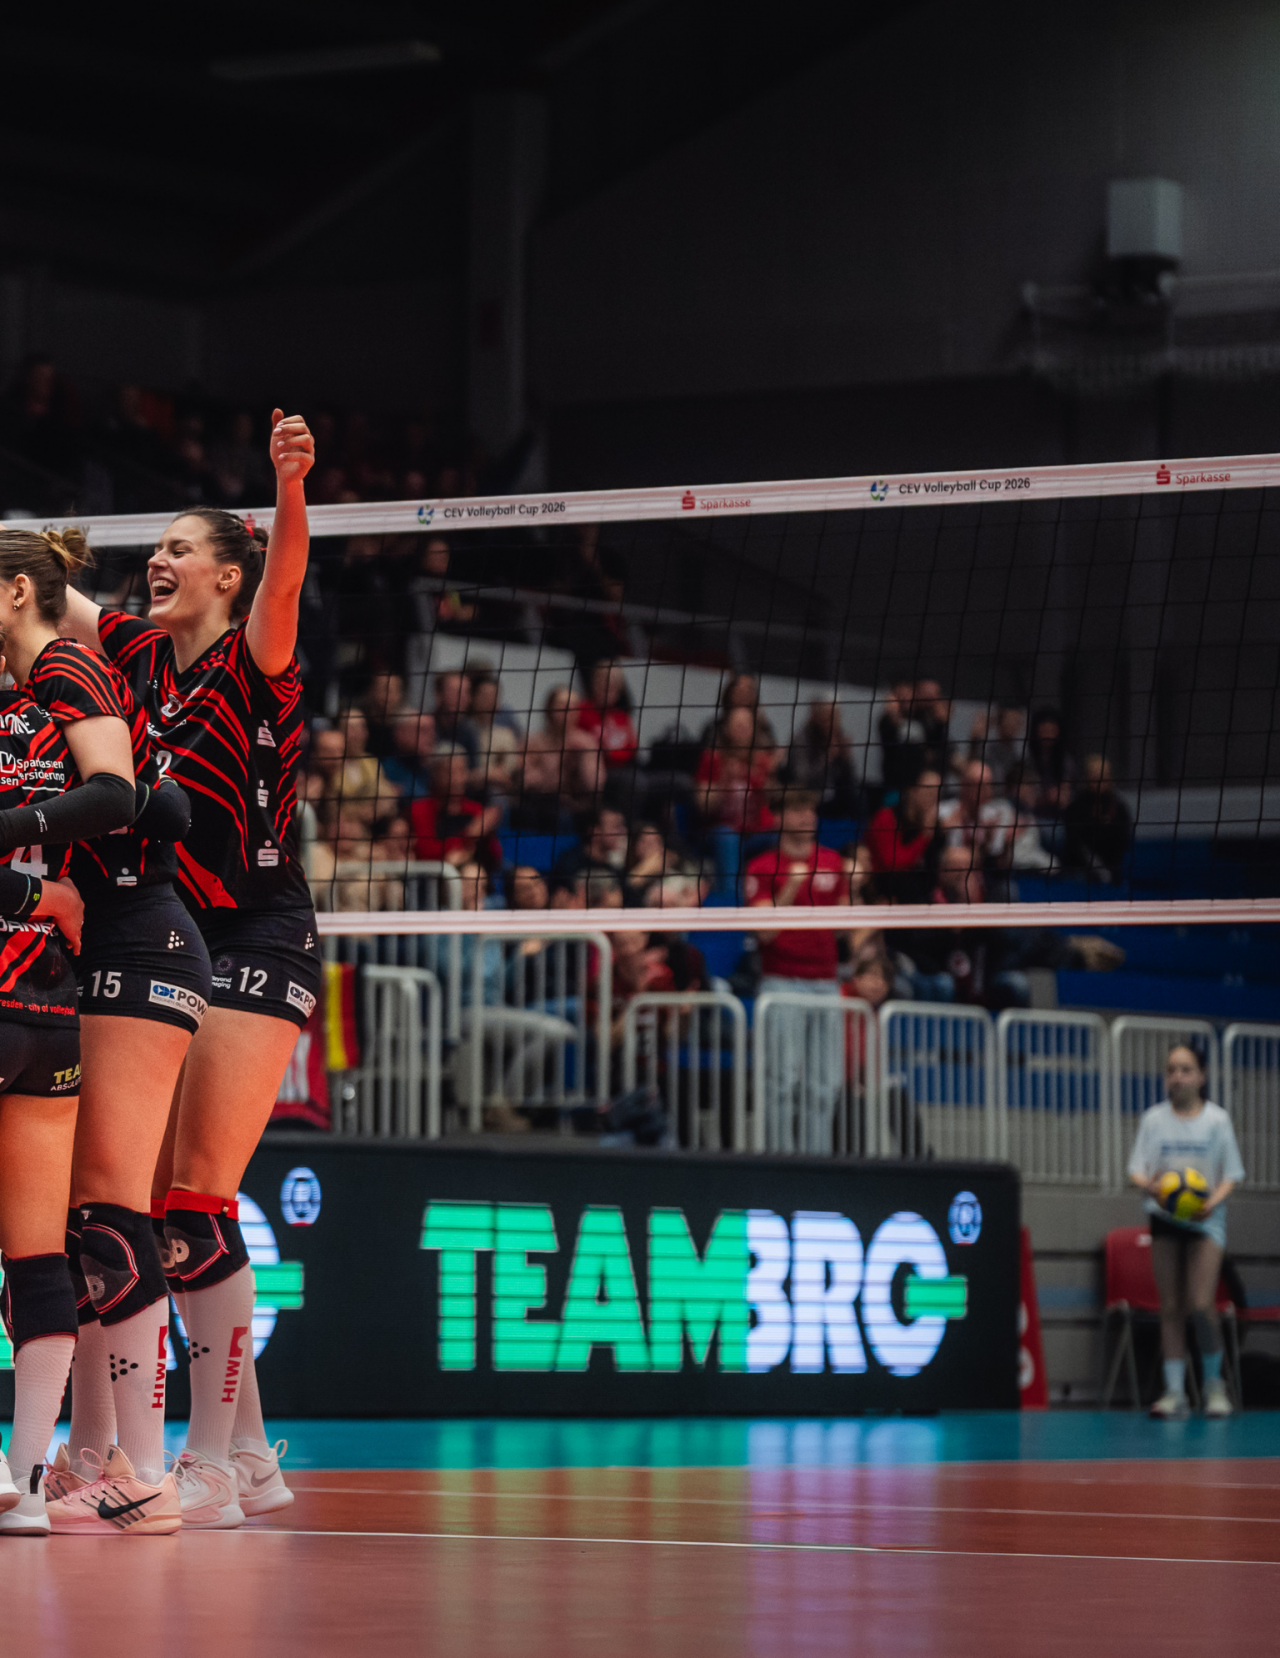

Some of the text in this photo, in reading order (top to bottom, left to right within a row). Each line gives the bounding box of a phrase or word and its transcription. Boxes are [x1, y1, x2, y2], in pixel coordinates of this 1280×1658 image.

[899, 477, 1031, 494] CEV Volleyball Cup 2026
[1176, 472, 1231, 486] Sparkasse
[444, 501, 566, 518] CEV Volleyball Cup 2026
[700, 498, 751, 511] Sparkasse
[91, 970, 122, 998] 15
[239, 966, 268, 997] 12
